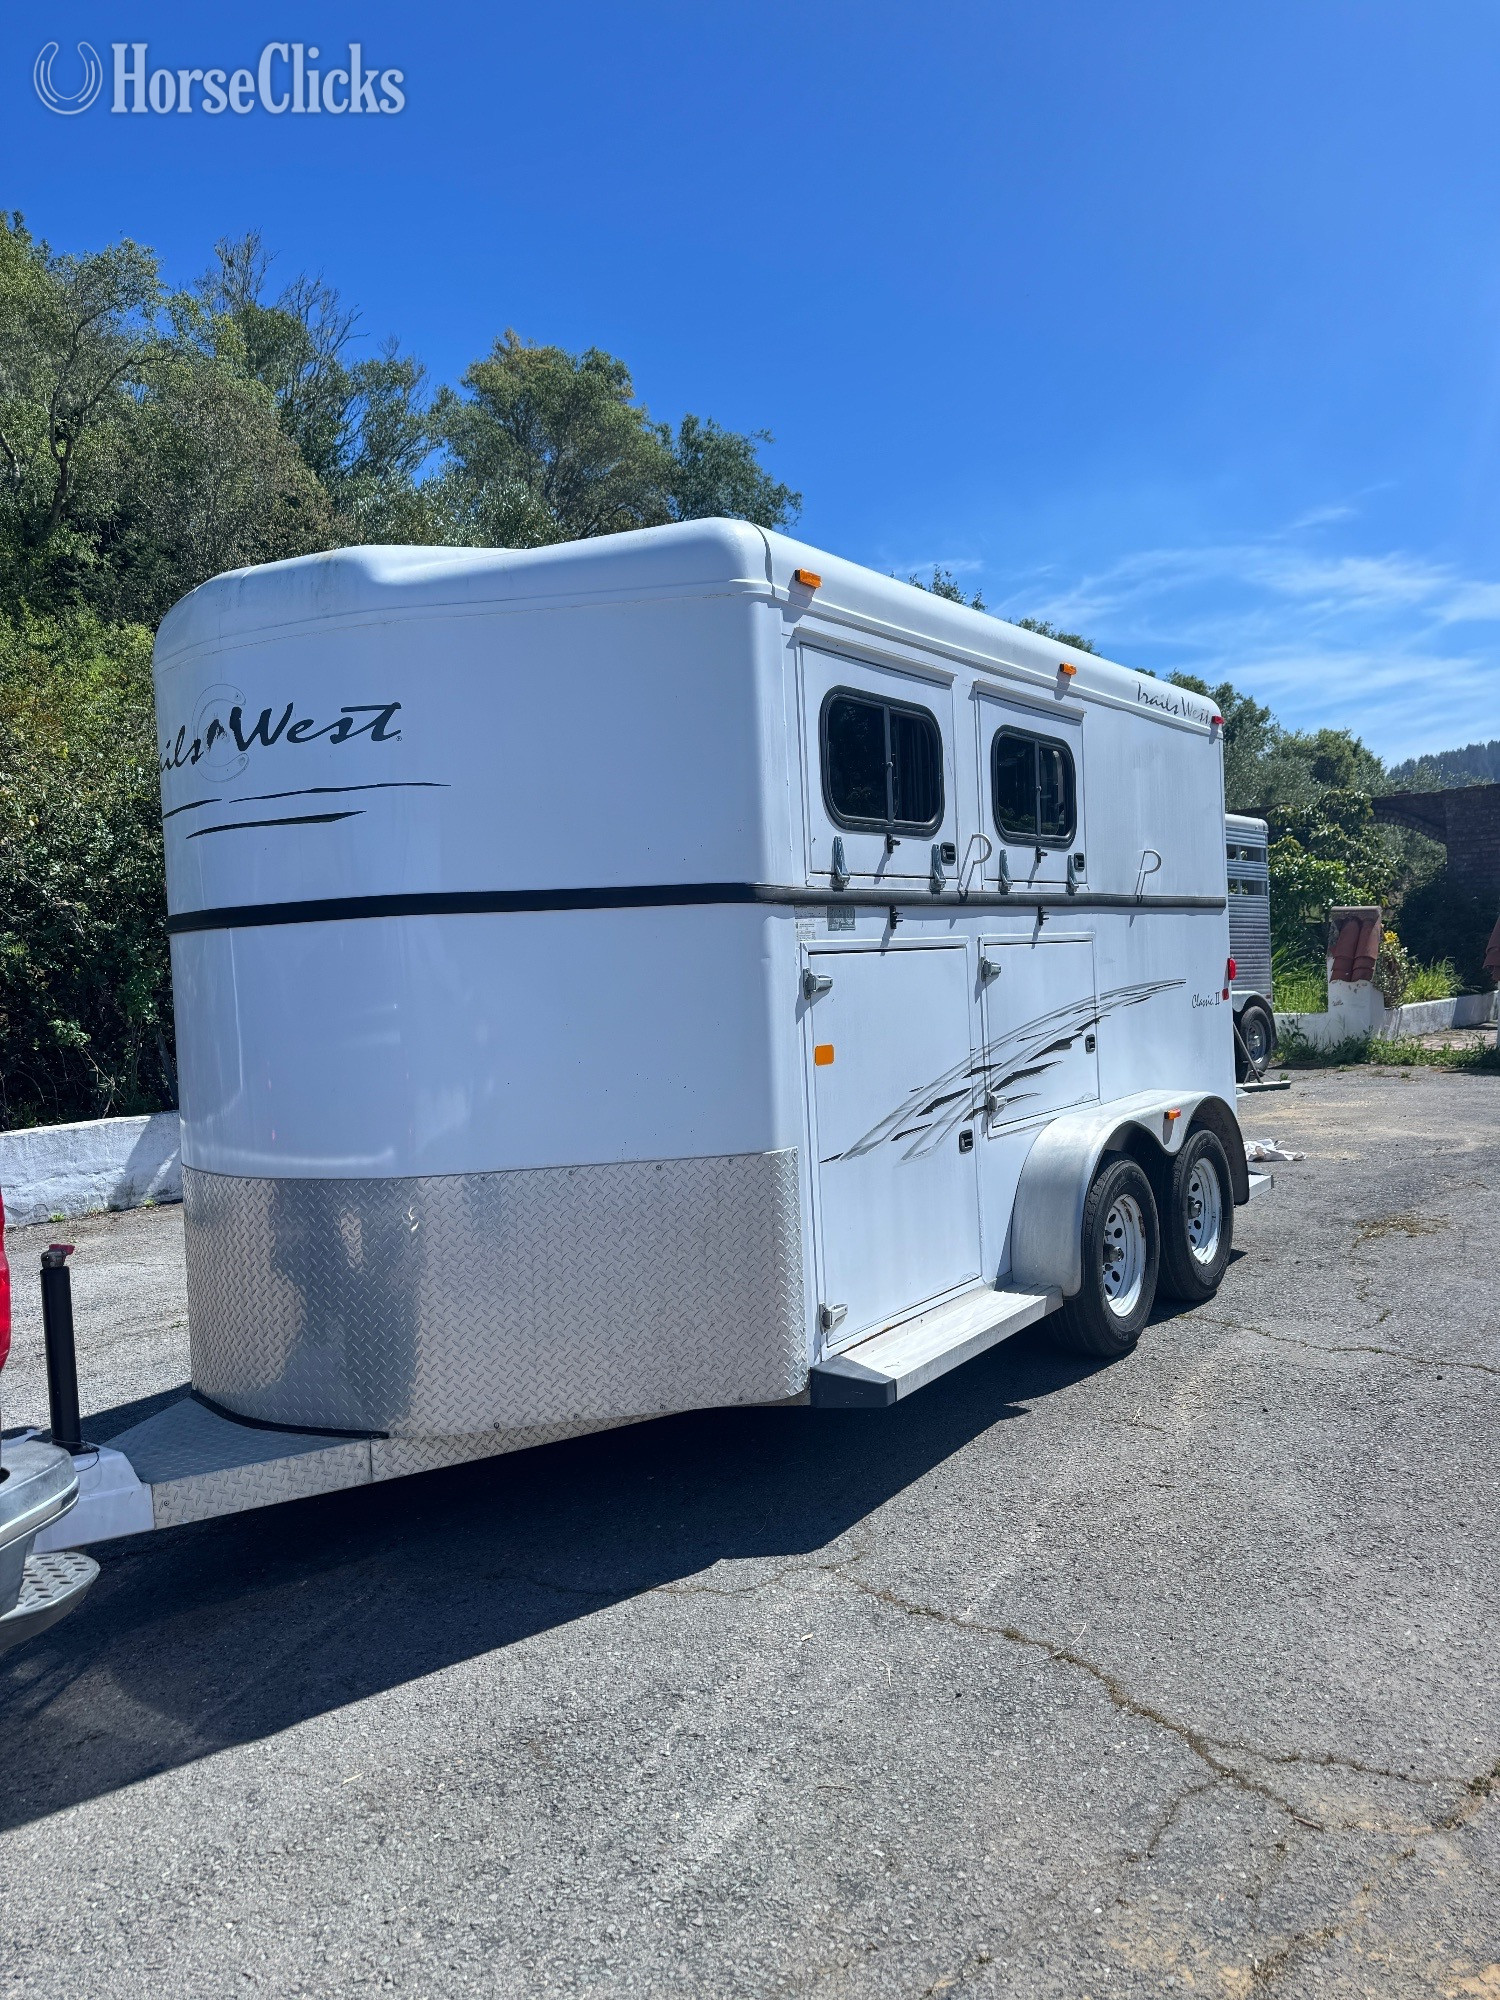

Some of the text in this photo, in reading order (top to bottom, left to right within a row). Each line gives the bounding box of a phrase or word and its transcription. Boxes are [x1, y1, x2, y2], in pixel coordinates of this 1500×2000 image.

[1134, 681, 1179, 715] Trails
[229, 702, 402, 752] West
[1192, 993, 1214, 1008] Classic
